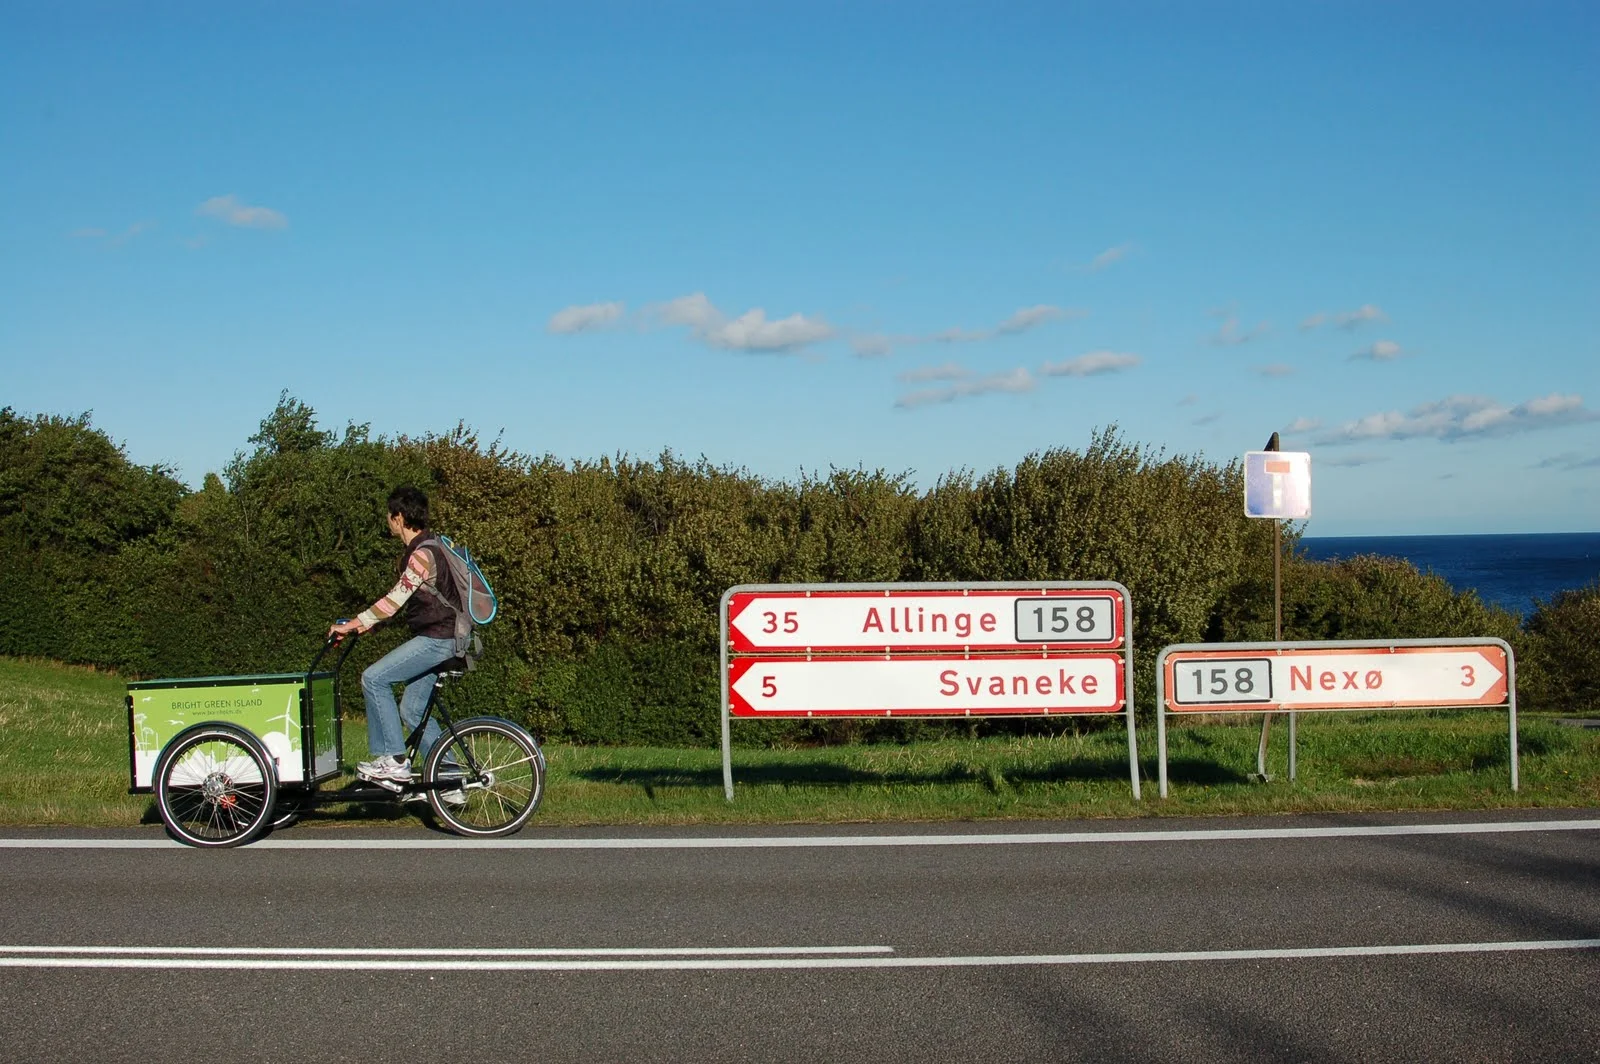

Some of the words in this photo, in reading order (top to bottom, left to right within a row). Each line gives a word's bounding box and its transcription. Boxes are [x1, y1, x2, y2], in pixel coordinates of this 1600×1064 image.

[762, 611, 799, 634] 35
[862, 606, 997, 638] Allinge
[1032, 605, 1096, 634] 158
[761, 675, 778, 698] 5
[939, 668, 1098, 697] Svaneke
[1191, 667, 1255, 695] 158
[1289, 664, 1384, 691] Nexø
[1460, 665, 1476, 688] 3
[171, 701, 201, 710] BRIGHT
[204, 700, 232, 709] GREEN
[234, 698, 263, 707] ISLAND
